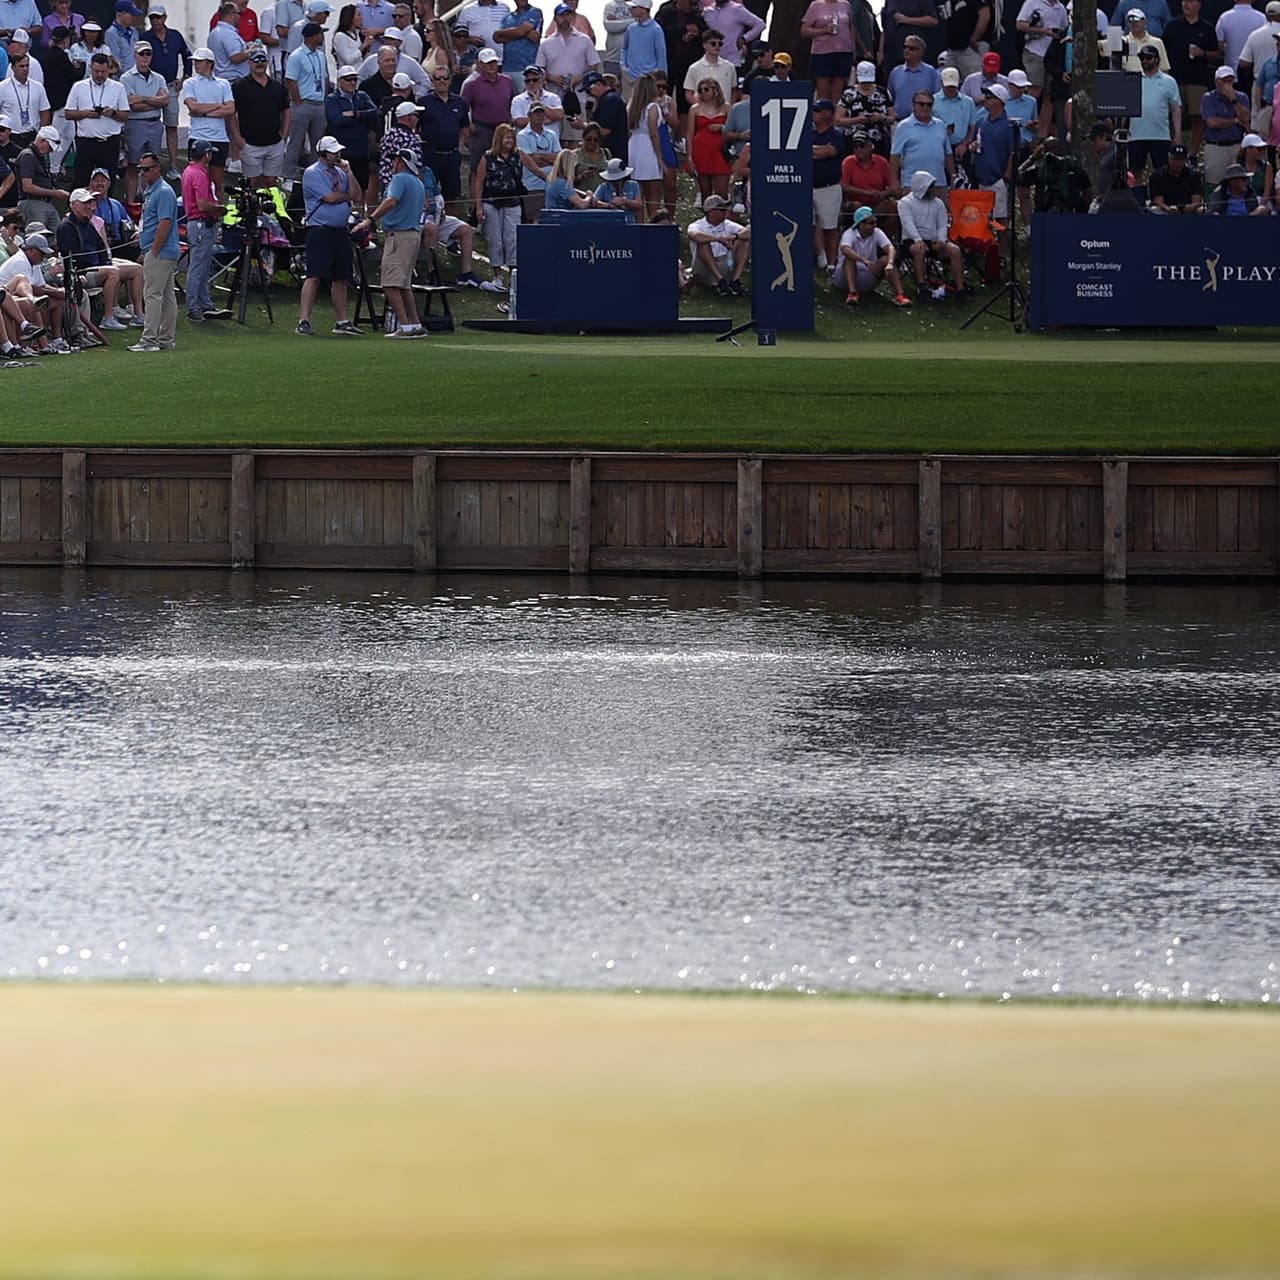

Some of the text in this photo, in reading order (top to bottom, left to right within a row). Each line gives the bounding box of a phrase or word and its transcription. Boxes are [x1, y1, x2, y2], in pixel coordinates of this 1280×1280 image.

[761, 99, 809, 150] 17
[774, 165, 794, 173] PAR 3
[766, 175, 802, 183] YARDS 141
[1080, 239, 1110, 249] Optum
[569, 249, 633, 259] THE PLAYERS
[1067, 261, 1122, 272] Morgan Stanley
[1153, 265, 1280, 281] THE PLAY
[1076, 283, 1113, 291] COMCAST
